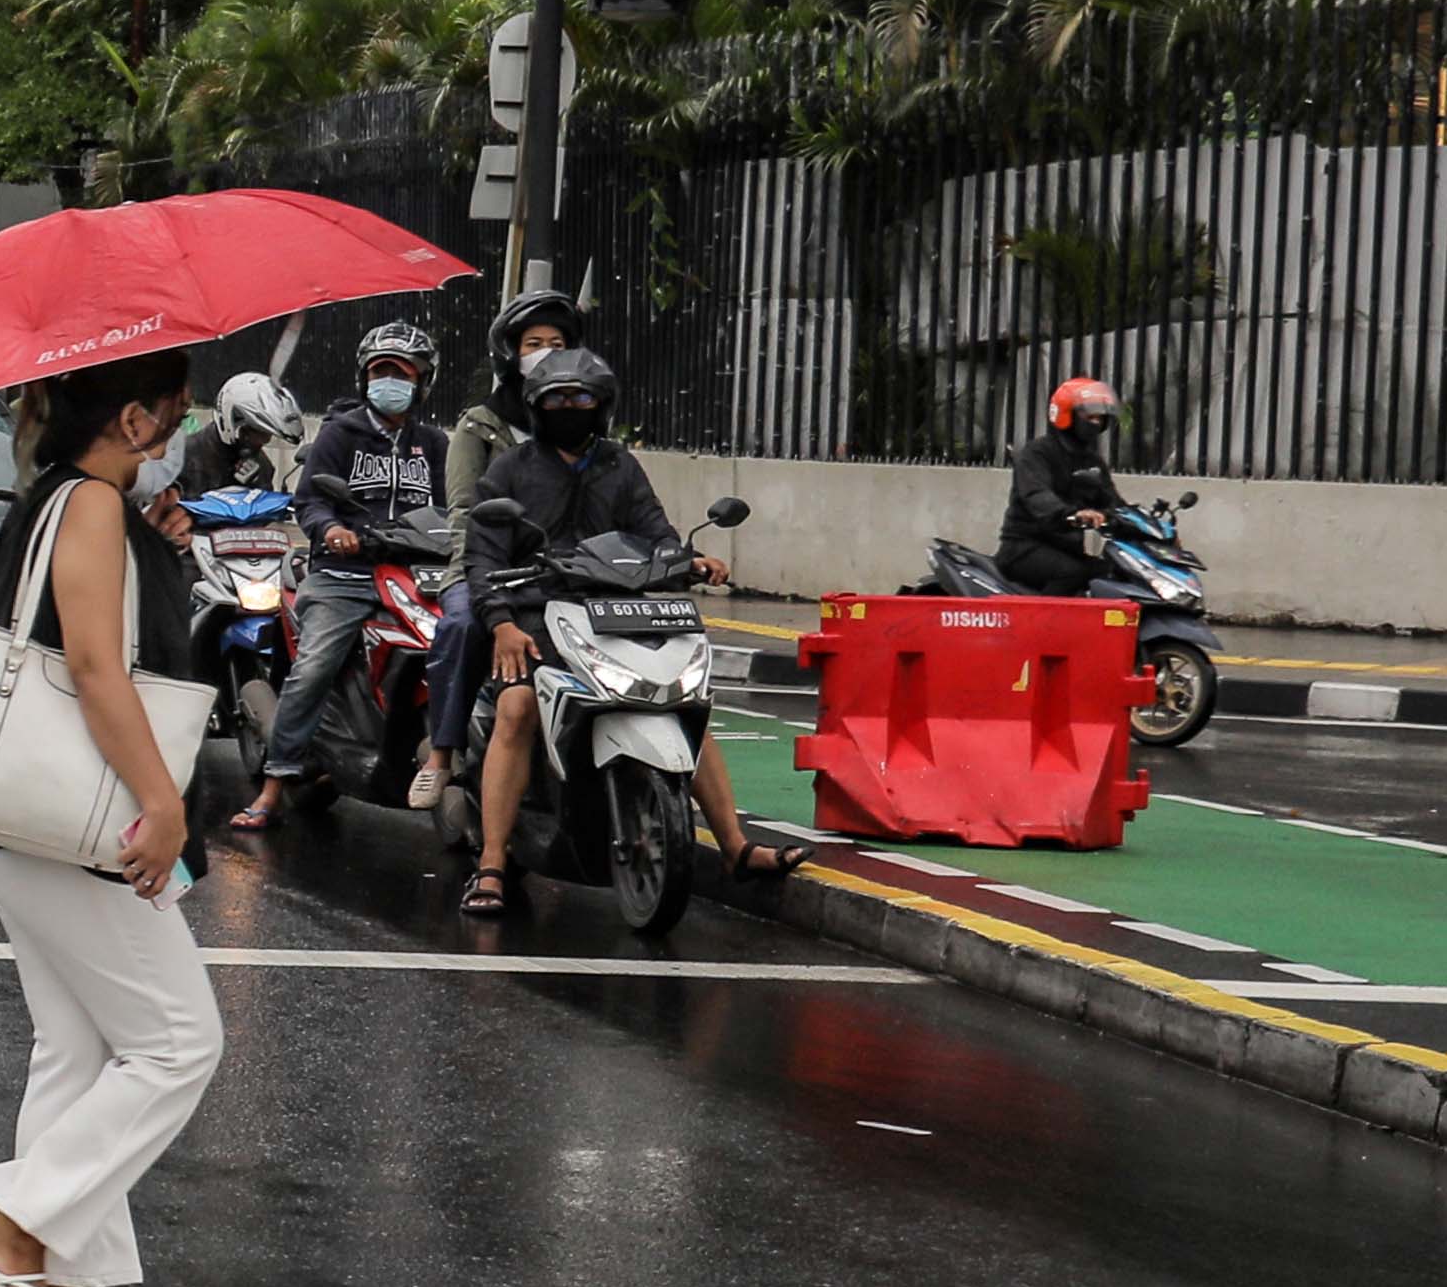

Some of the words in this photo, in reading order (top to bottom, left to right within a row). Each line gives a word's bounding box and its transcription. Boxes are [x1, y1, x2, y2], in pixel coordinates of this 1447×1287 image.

[35, 337, 98, 365] BANK
[124, 312, 164, 341] DKI
[349, 449, 431, 485] LONDON
[593, 604, 605, 616] B
[612, 604, 652, 616] 6016
